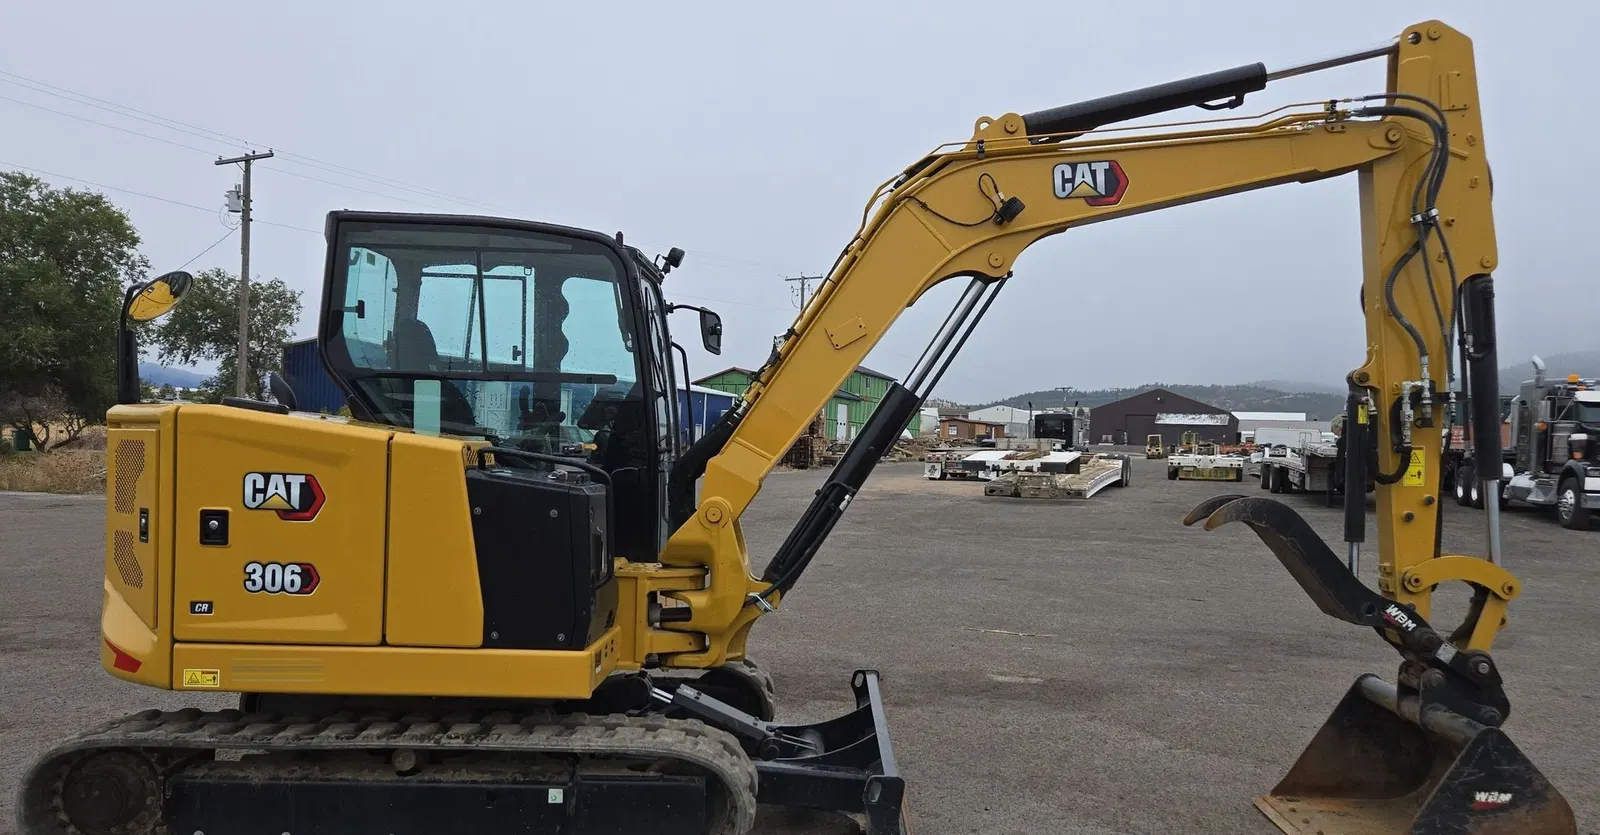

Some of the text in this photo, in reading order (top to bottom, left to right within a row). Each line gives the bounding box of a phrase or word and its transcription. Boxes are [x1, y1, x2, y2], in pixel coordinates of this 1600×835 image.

[1053, 161, 1109, 198] CAT
[243, 472, 306, 510] CAT
[245, 562, 302, 593] 306
[195, 603, 209, 612] CR
[1386, 604, 1417, 631] WBM
[1475, 791, 1513, 802] WBM
